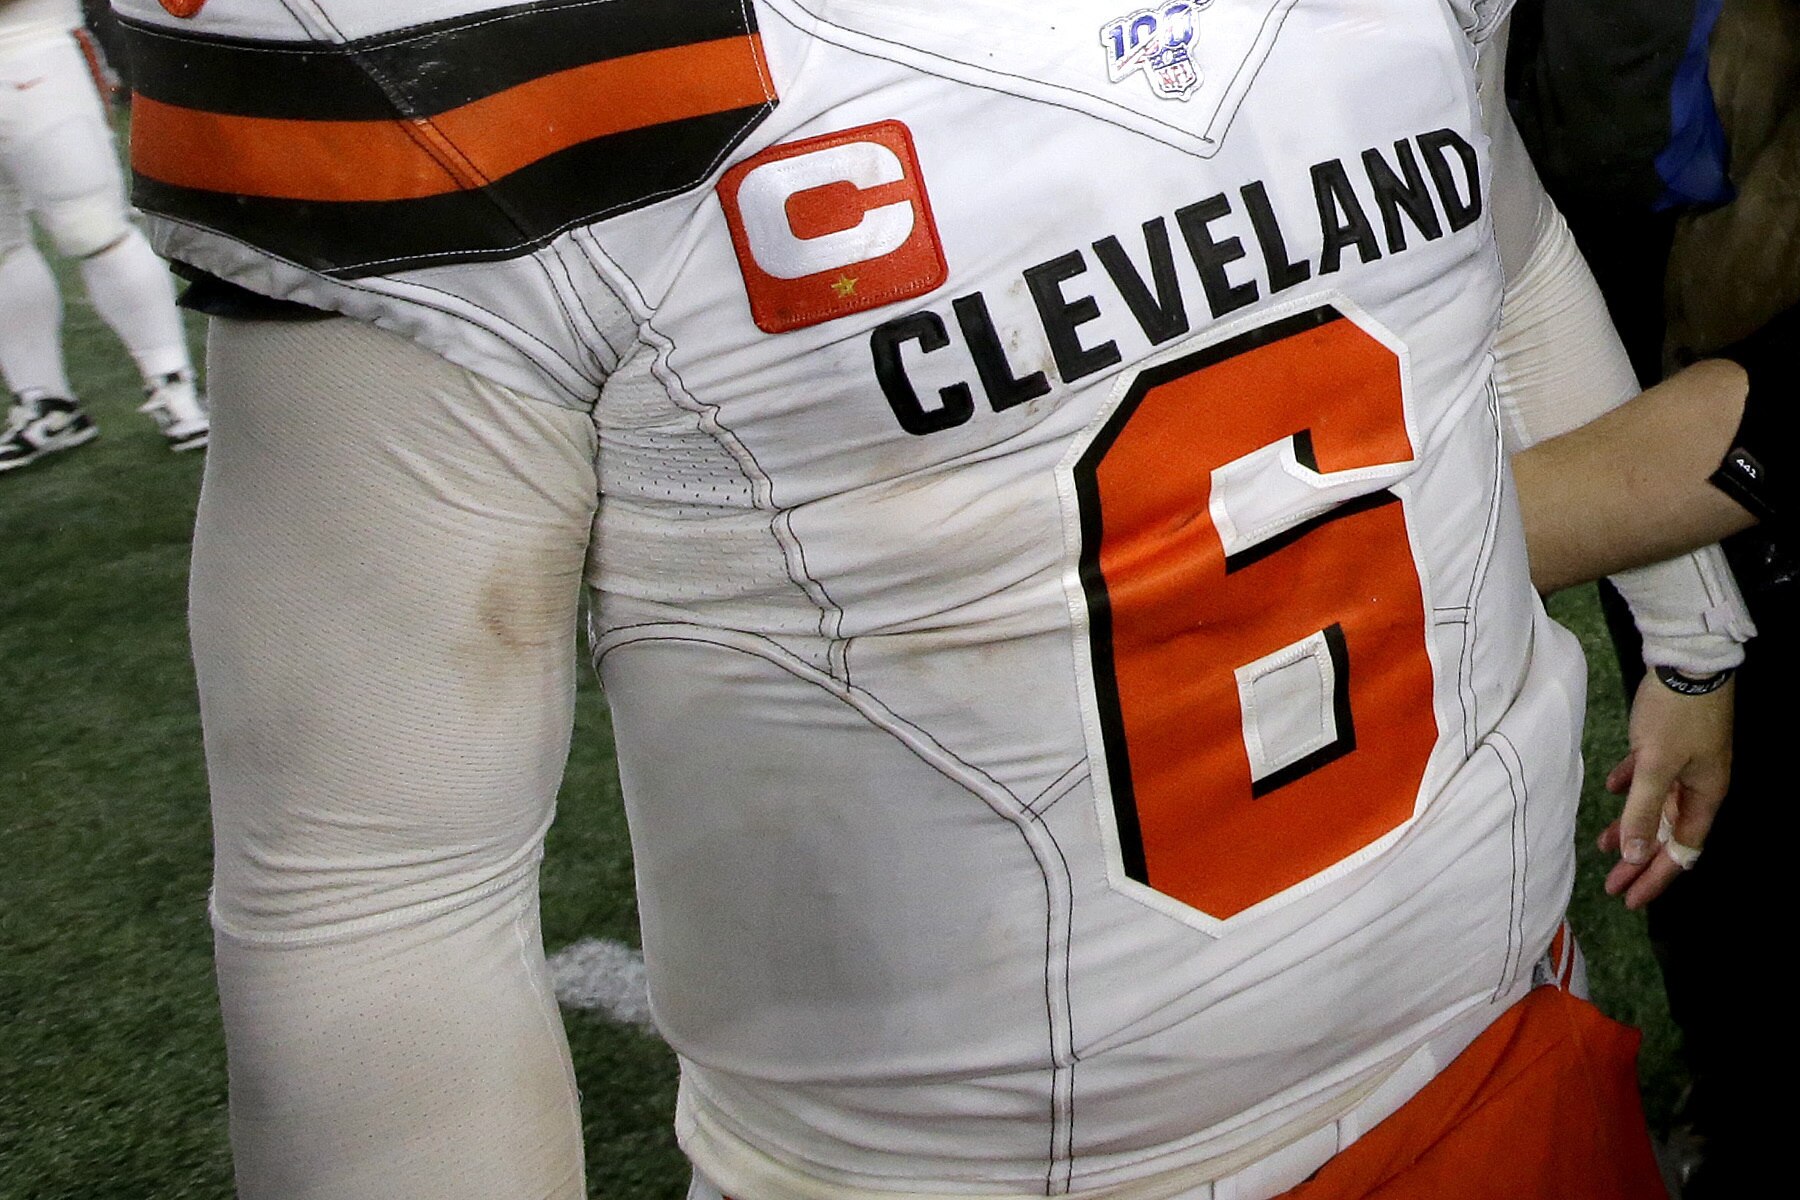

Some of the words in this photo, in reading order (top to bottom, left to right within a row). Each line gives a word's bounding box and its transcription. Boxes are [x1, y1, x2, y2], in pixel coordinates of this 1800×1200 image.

[737, 141, 915, 279] C
[870, 127, 1484, 437] CLEVELAND
[1055, 290, 1440, 938] 6
